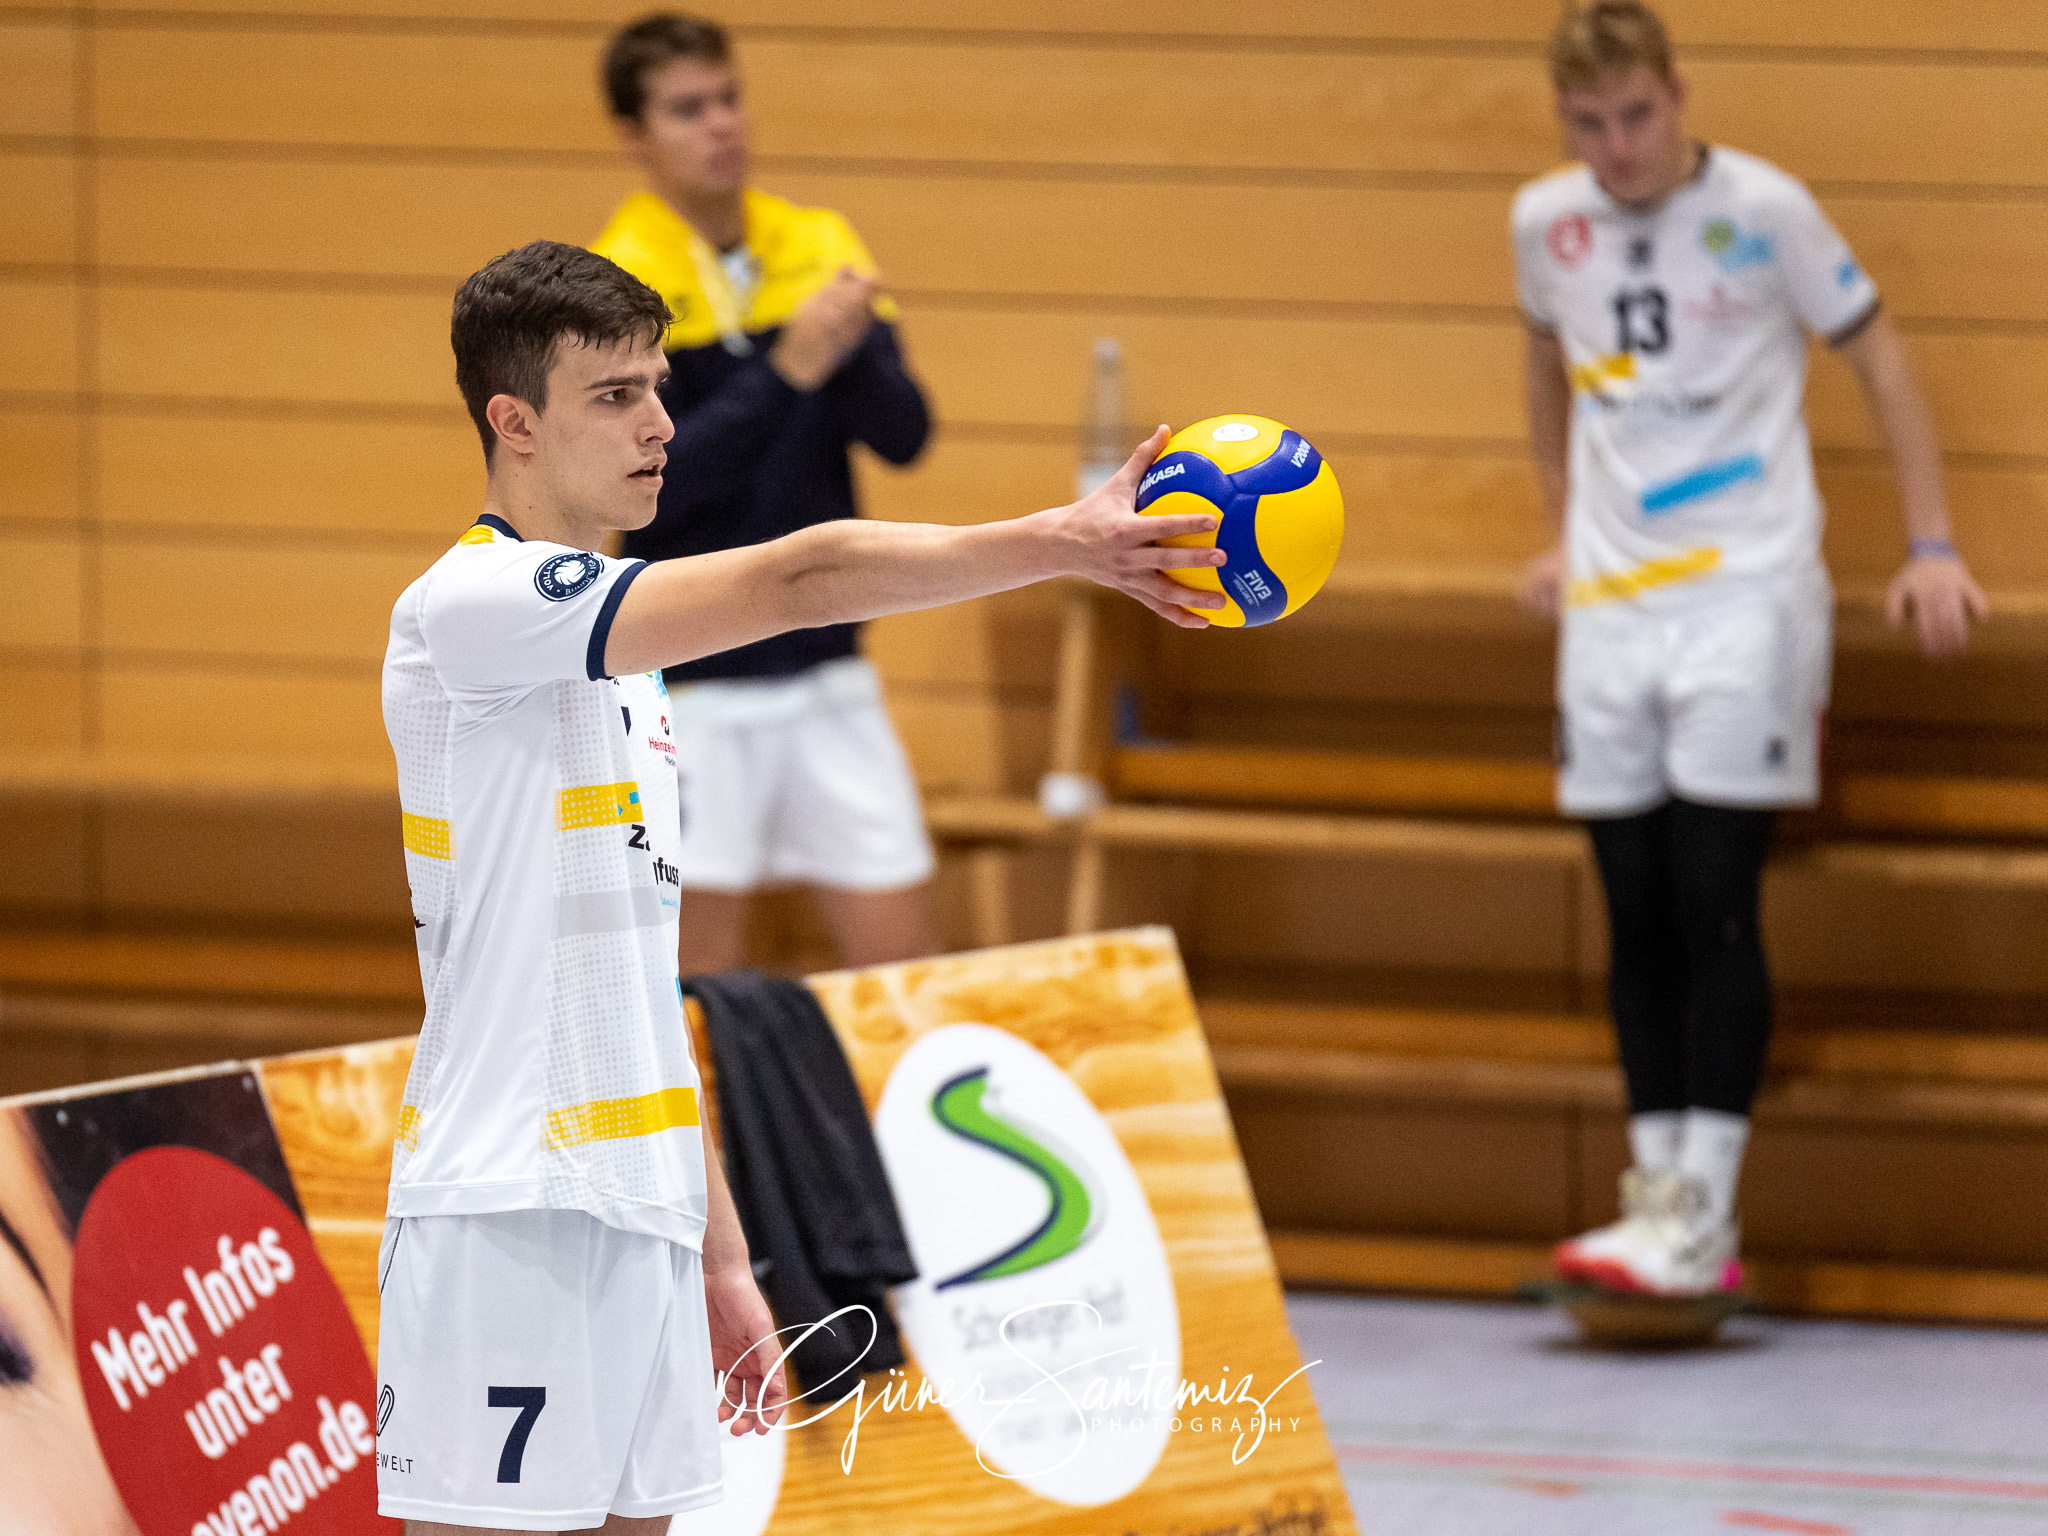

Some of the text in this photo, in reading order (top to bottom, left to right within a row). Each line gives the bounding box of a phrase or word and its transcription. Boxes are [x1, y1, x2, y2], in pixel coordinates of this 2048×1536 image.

[1612, 283, 1669, 356] 13
[1243, 569, 1272, 600] FIVB
[90, 1226, 296, 1412] Mehr Infos
[184, 1342, 294, 1460] unter
[487, 1385, 547, 1484] 7
